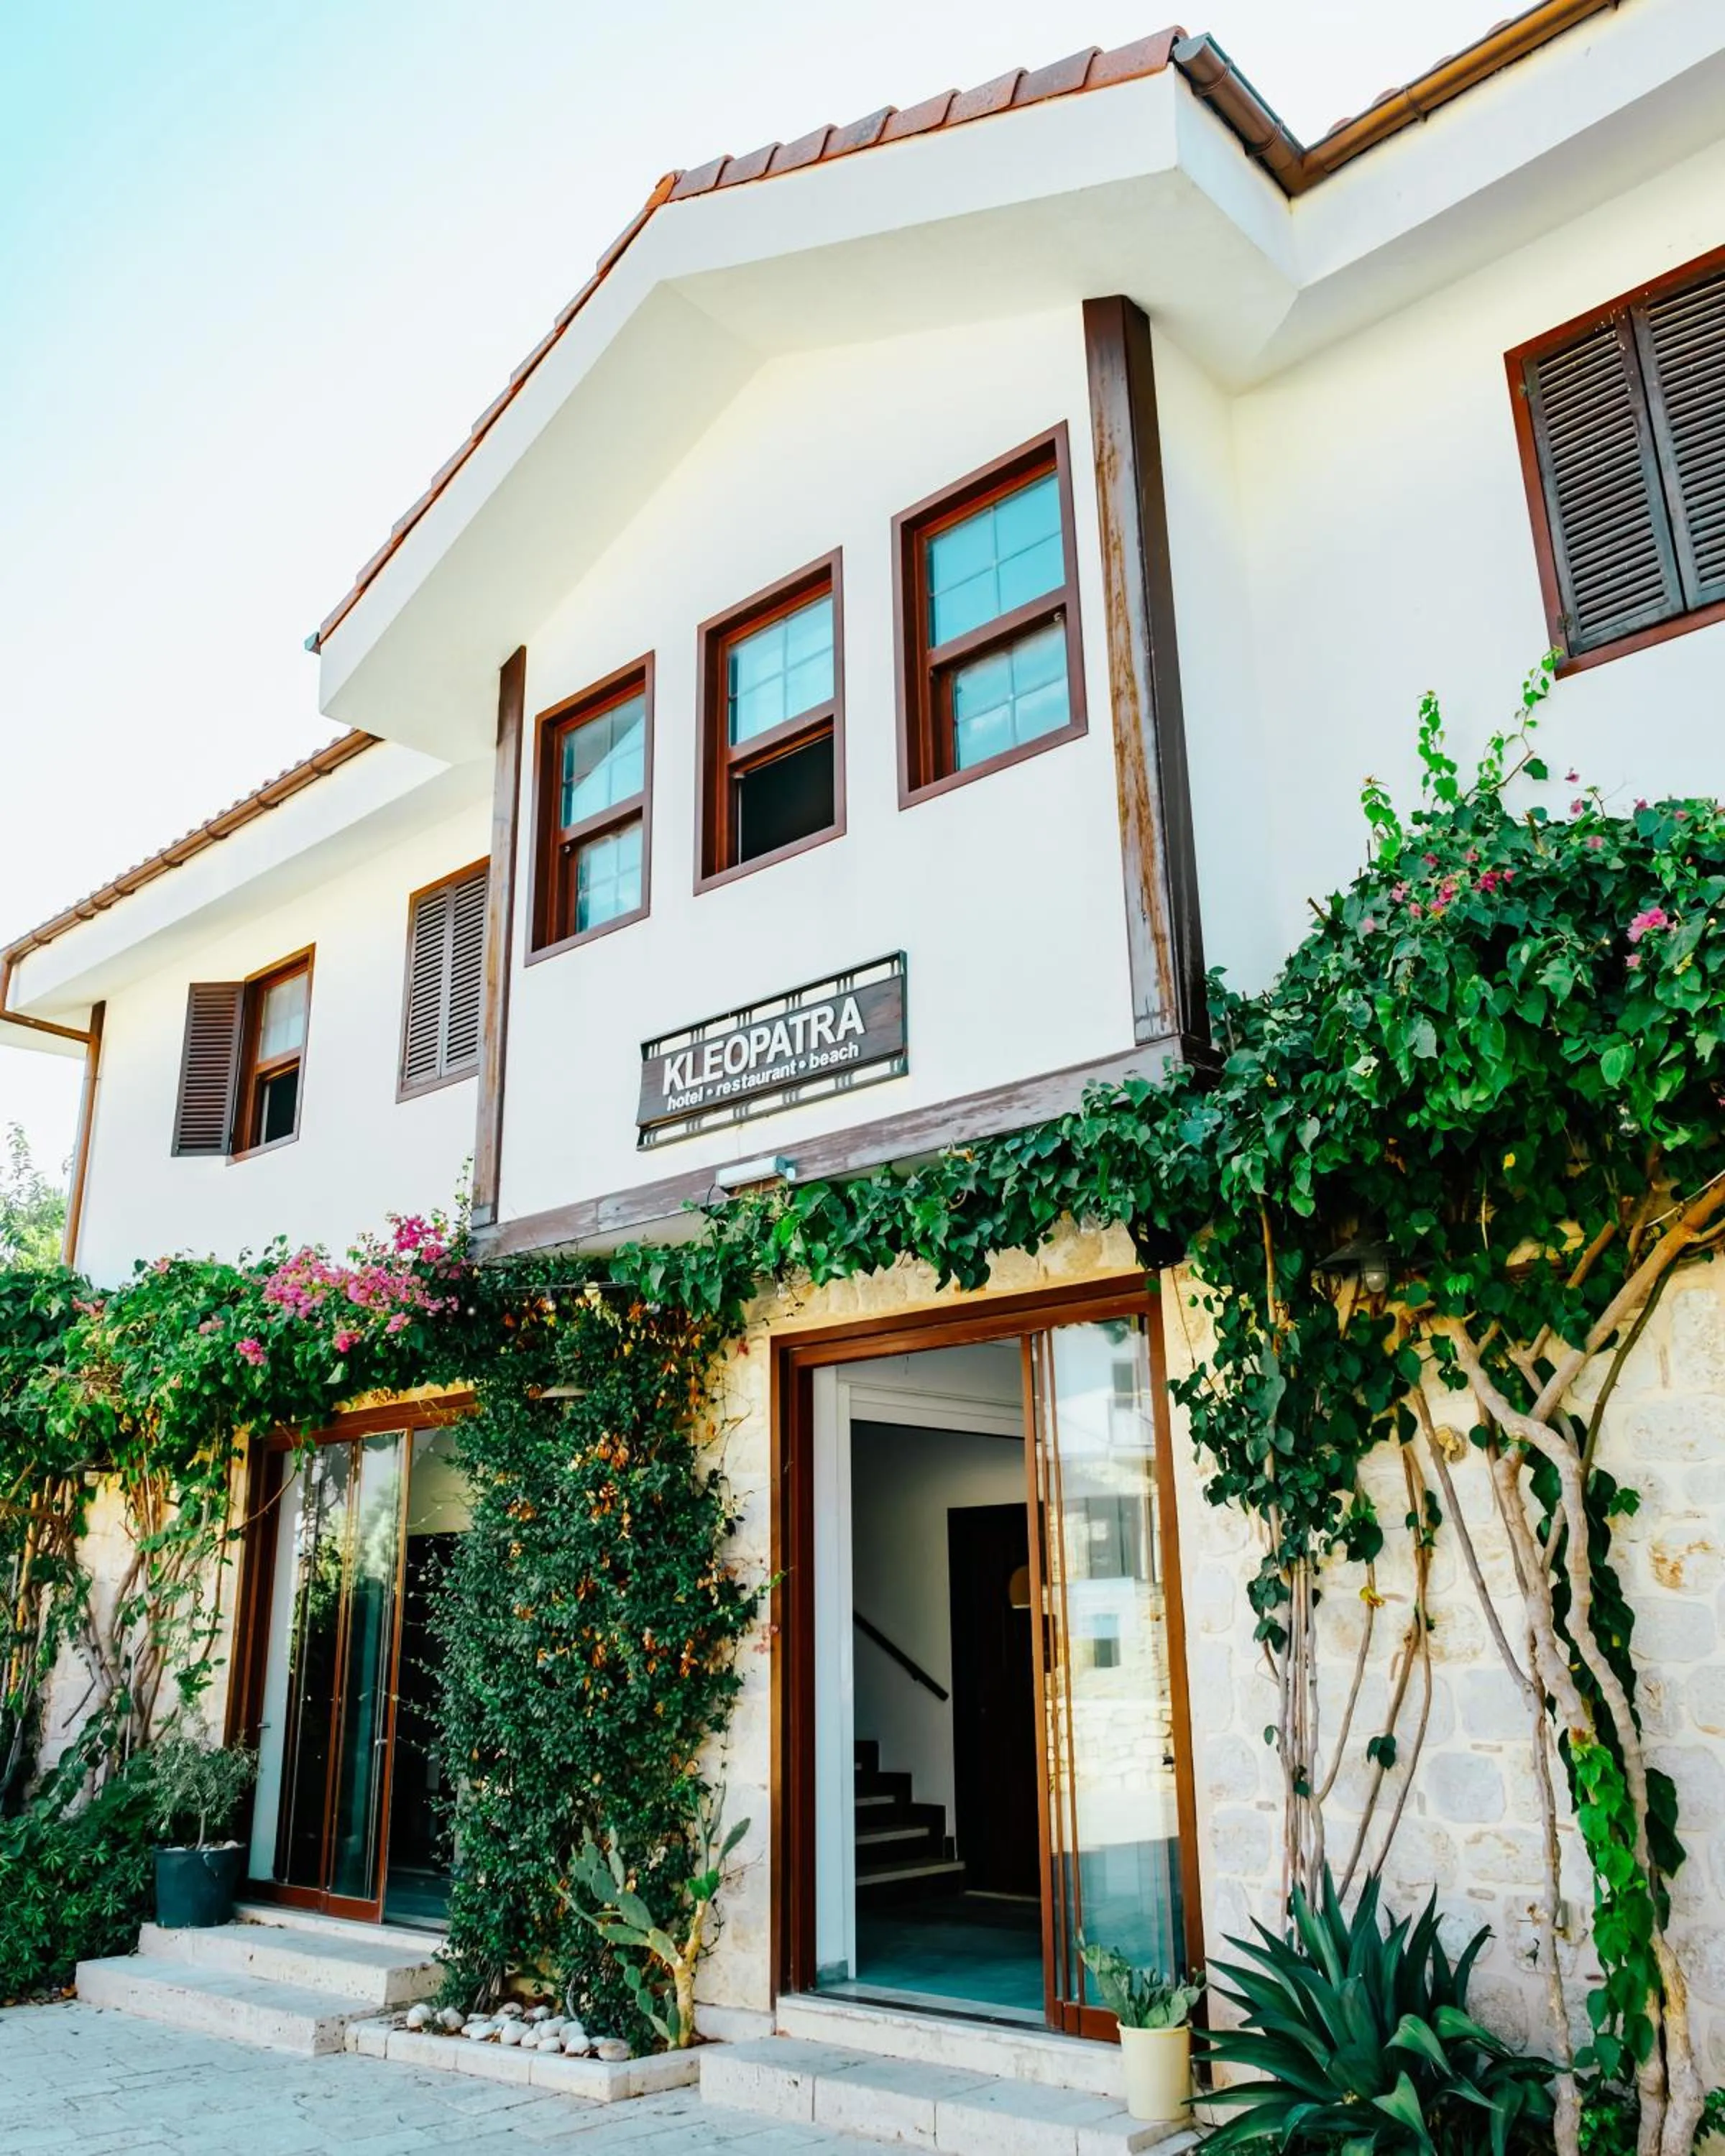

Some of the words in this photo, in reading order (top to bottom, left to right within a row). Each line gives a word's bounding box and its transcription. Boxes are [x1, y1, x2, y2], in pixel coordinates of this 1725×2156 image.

[662, 996, 865, 1096] KLEOPATRA
[666, 1087, 703, 1111] hotel
[716, 1059, 796, 1097] restaurant
[809, 1042, 859, 1069] beach
